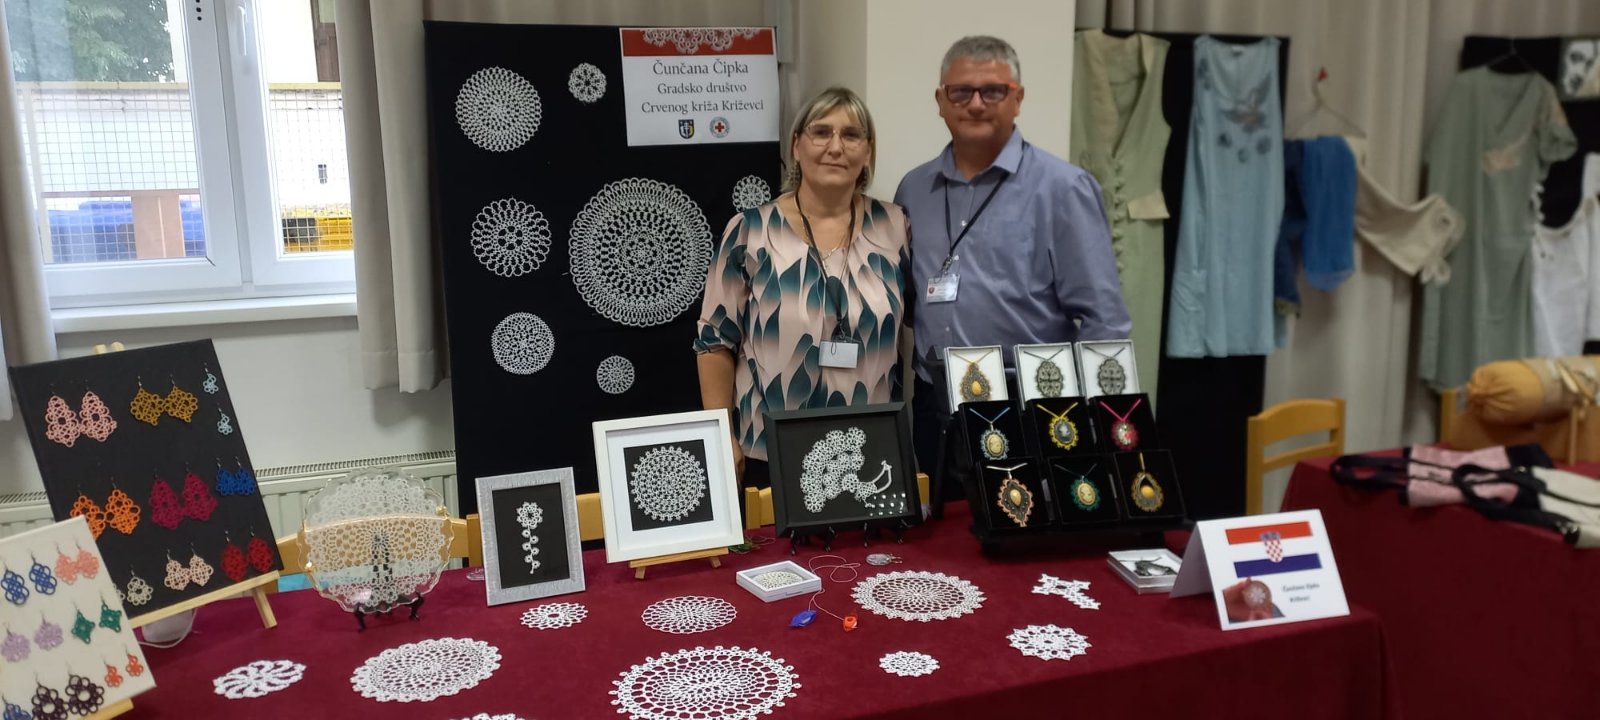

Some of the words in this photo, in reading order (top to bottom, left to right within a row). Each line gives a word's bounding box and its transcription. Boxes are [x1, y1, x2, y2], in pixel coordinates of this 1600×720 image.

[653, 59, 708, 75] Čunčana
[713, 59, 749, 77] Čipka
[657, 83, 703, 94] Gradsko
[706, 82, 747, 93] društvo
[641, 101, 688, 115] Crvenog
[692, 100, 719, 112] križa
[722, 99, 764, 111] Križevci
